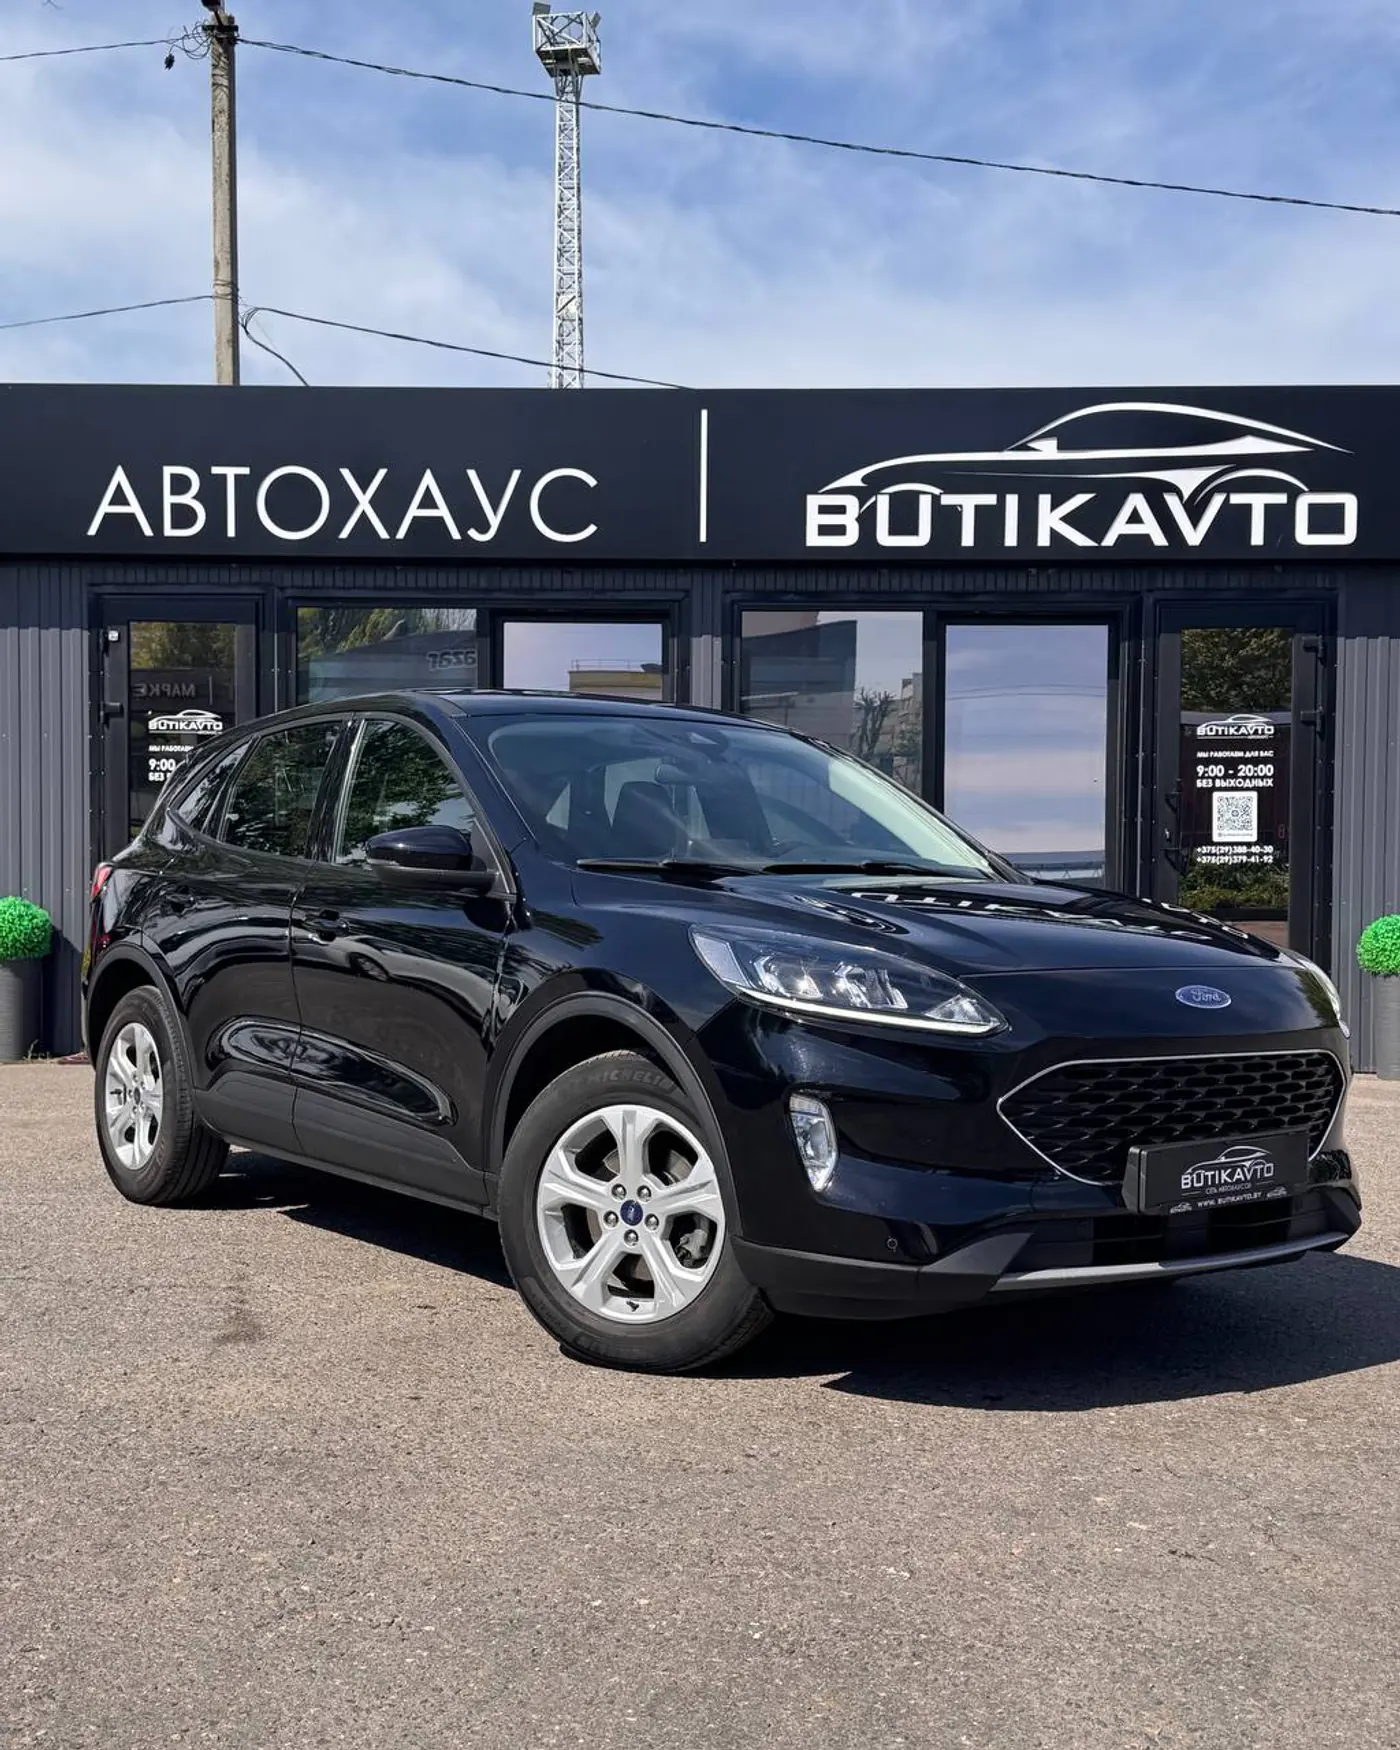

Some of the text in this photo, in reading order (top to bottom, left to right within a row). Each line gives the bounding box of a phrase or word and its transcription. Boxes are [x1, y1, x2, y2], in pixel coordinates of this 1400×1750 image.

[87, 464, 599, 543] АВТОХАУС
[805, 491, 1358, 548] BUTIKAVTO
[148, 720, 223, 730] BUTIKAVTO
[1197, 725, 1274, 736] BUTIKAVTO
[148, 758, 176, 771] 9:00
[1196, 764, 1225, 777] 9:00
[1237, 764, 1274, 777] 20:00
[148, 772, 165, 781] БЕЗ
[1196, 778, 1274, 788] БЕЗ ВЫХОДНЫХ
[1190, 988, 1221, 1002] Ford
[1181, 1163, 1274, 1190] BUTIKAVTO
